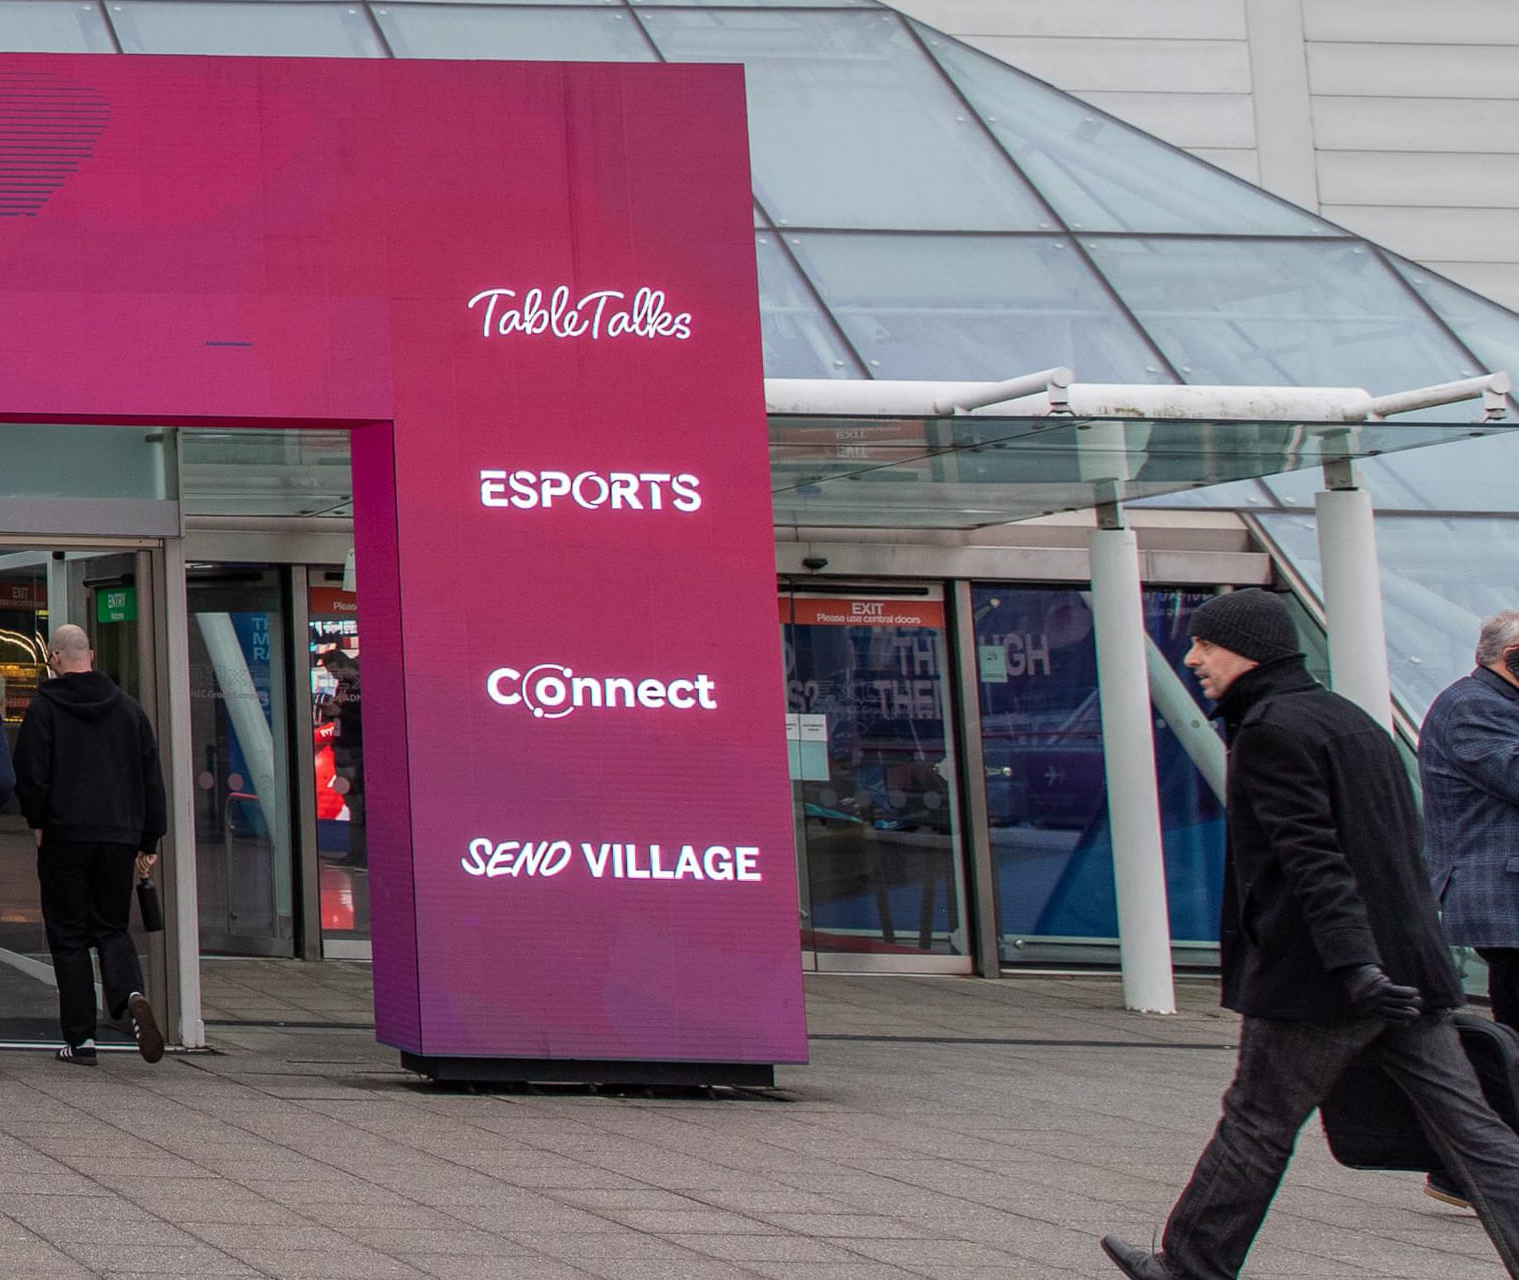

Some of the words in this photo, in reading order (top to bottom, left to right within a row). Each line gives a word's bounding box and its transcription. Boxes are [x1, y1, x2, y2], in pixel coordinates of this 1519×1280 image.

[467, 285, 692, 340] TableTalks
[480, 470, 702, 512] ESPORTS
[12, 587, 28, 599] EXIT
[108, 592, 126, 609] ENTRY
[816, 613, 845, 623] Please
[846, 615, 862, 623] use
[863, 615, 893, 624] central
[894, 615, 921, 625] doors
[851, 602, 884, 616] EXIT
[487, 663, 718, 719] Connect
[461, 837, 572, 878] SEND
[580, 843, 762, 882] VILLAGE
